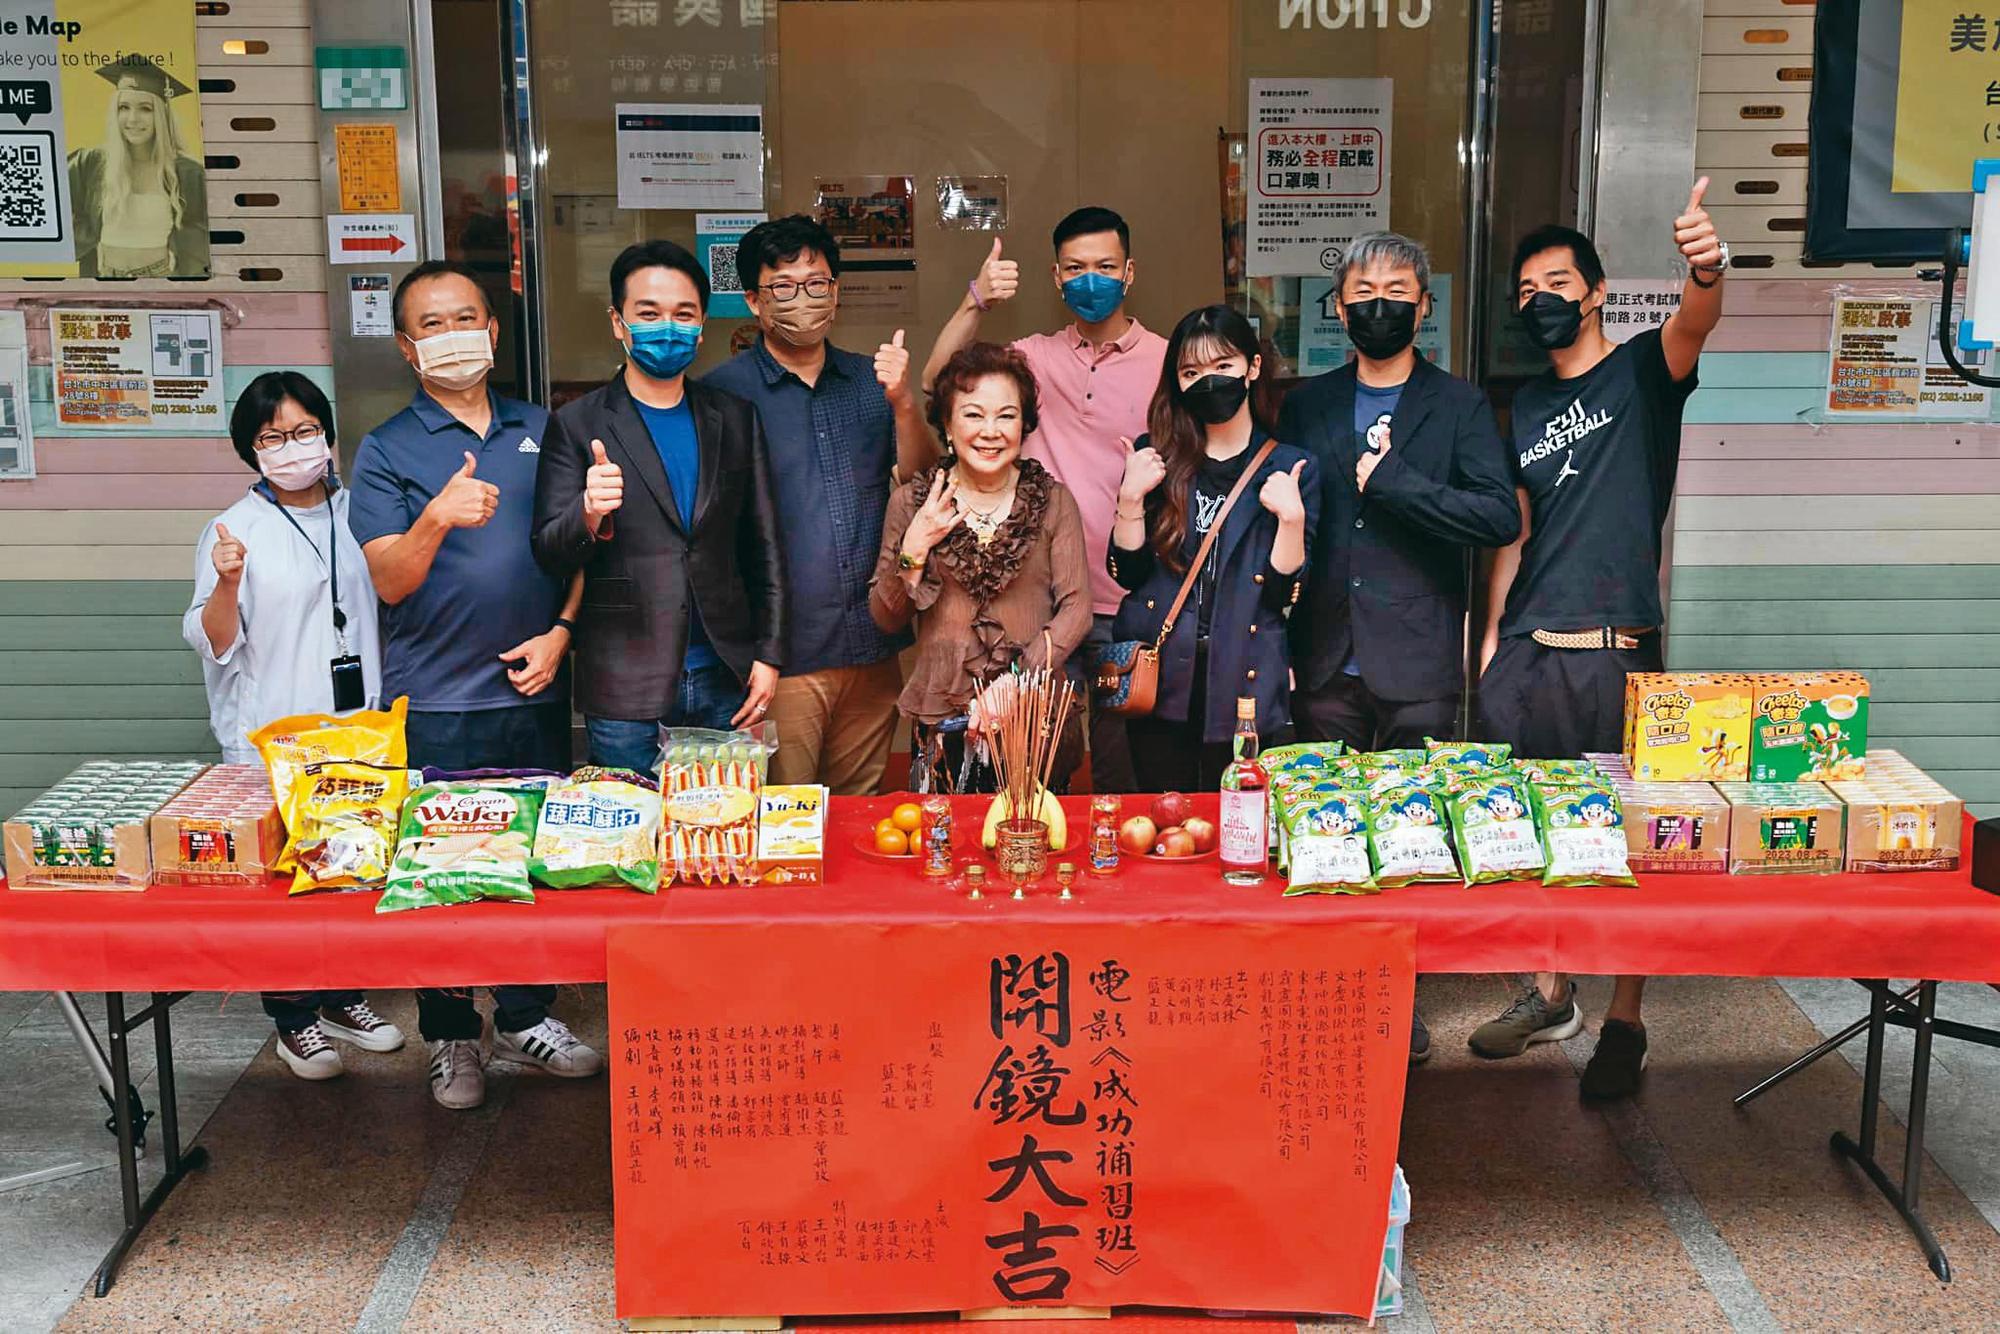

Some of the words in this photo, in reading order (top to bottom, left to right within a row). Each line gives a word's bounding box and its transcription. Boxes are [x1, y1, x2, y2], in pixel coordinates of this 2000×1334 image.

[26, 15, 82, 42] Map
[28, 54, 57, 70] you
[62, 55, 79, 66] to
[84, 51, 110, 66] the
[115, 51, 164, 67] future
[9, 89, 36, 105] ME
[1267, 150, 1375, 168] 務必全程配戴
[1633, 311, 1647, 323] 28
[1519, 408, 1613, 470] BASKETBALL
[1644, 690, 1692, 713] Cheetos
[1759, 690, 1808, 714] Cheetos
[413, 805, 517, 824] Wafer
[546, 803, 640, 828] 蔬菜蘇打
[767, 801, 817, 812] Yu-Ki
[1235, 969, 1250, 1016] 出品人
[1376, 963, 1391, 1039] 出品公司
[623, 1027, 642, 1066] 編劇
[973, 951, 1088, 1302] 開鏡大吉
[1080, 960, 1140, 1275] 電影《成功補習班》
